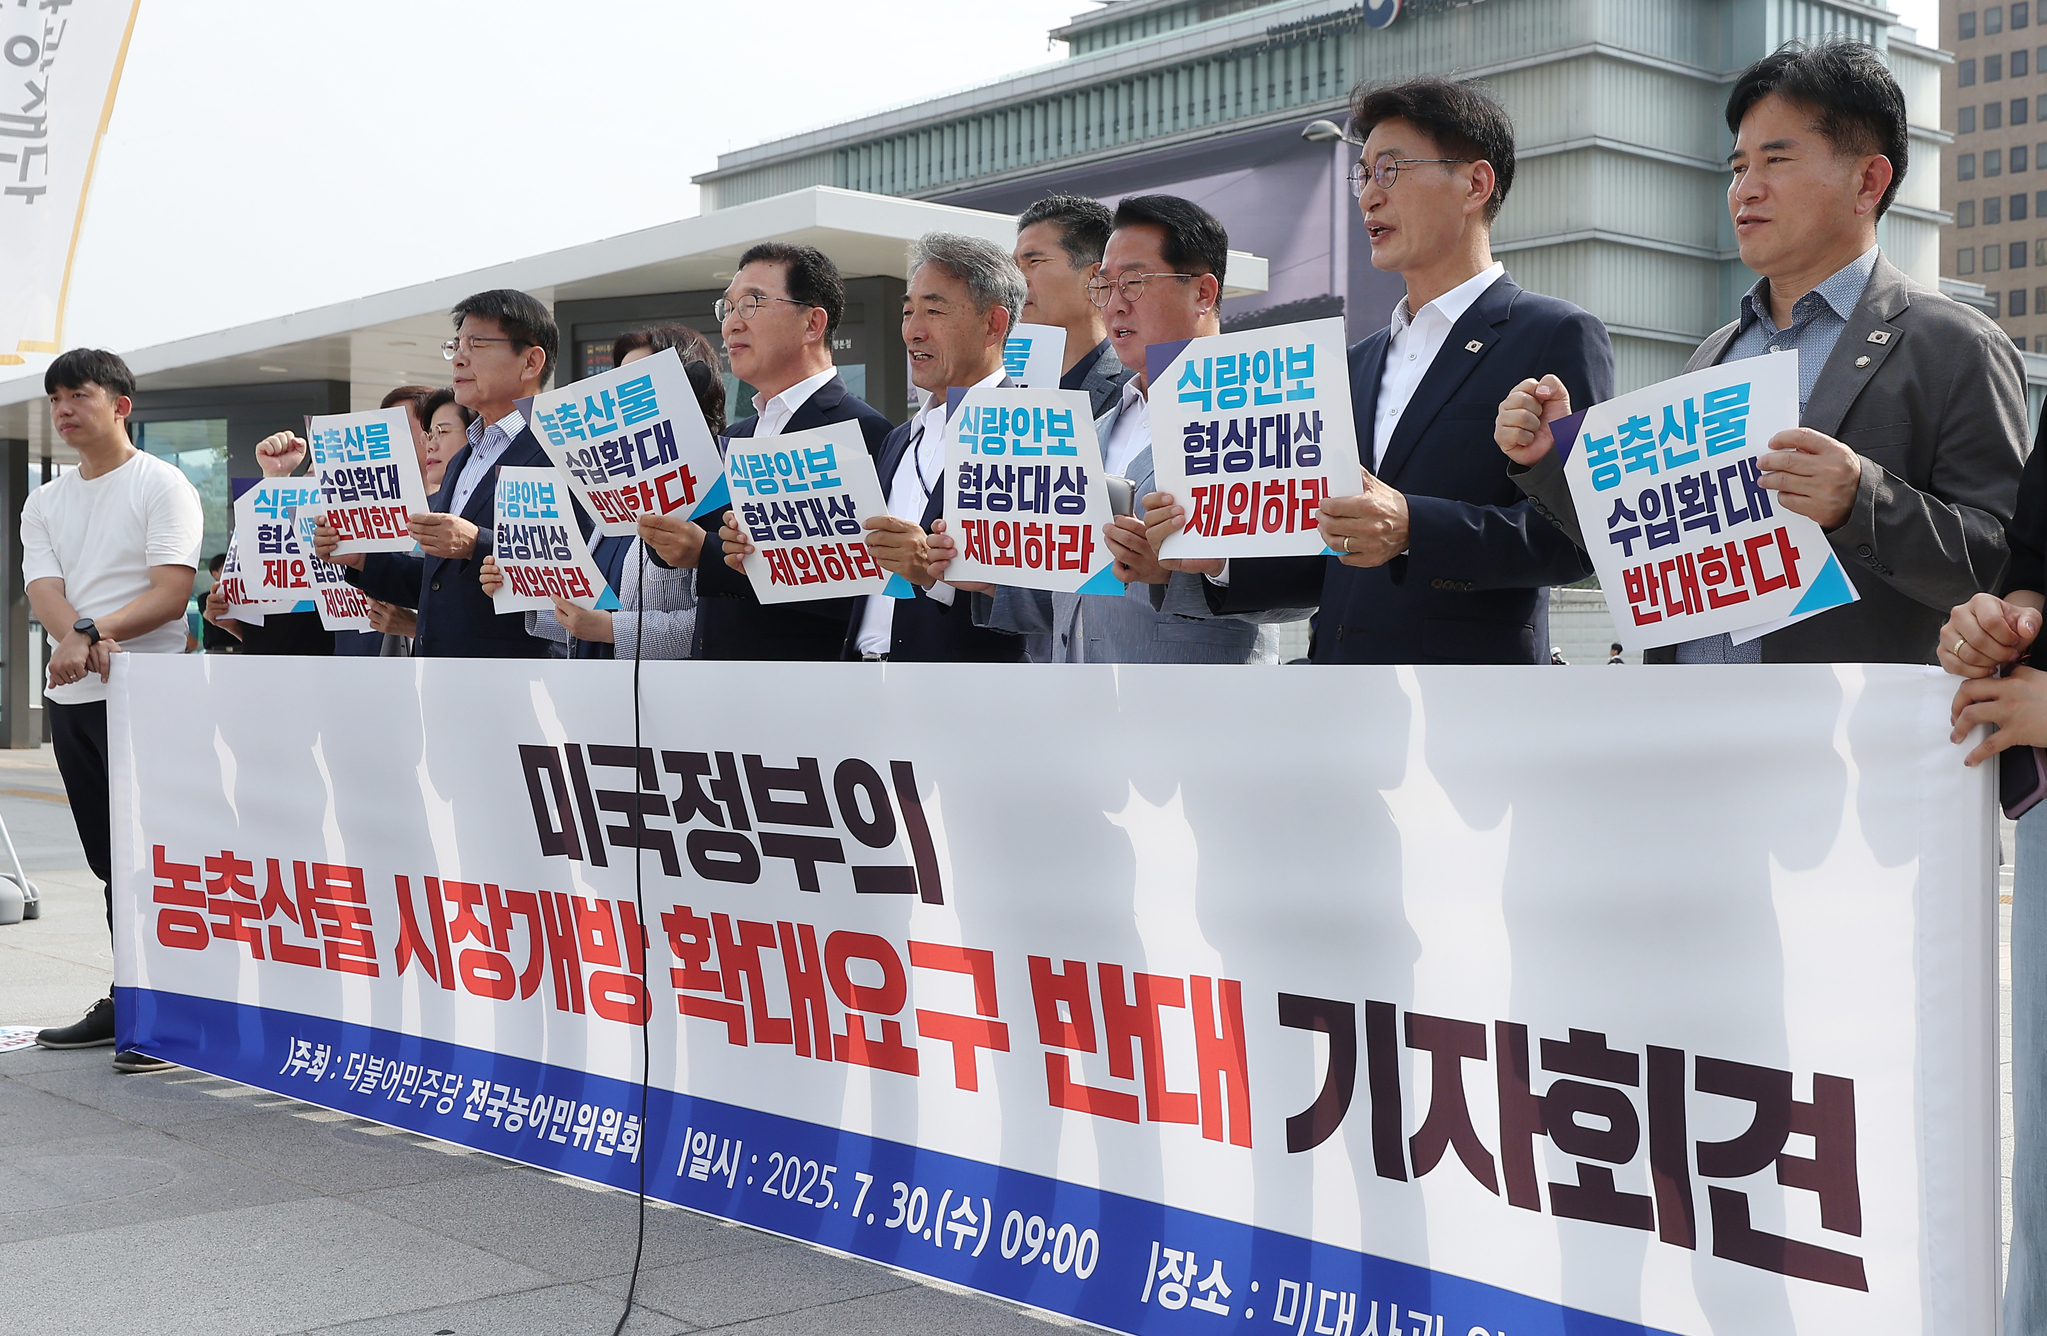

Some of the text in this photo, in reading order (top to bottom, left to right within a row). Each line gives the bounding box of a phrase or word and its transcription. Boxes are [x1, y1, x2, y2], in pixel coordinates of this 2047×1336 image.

[1177, 343, 1315, 412] 식량안보
[535, 374, 660, 446] 농축산물
[959, 405, 1078, 456] 식량안보
[1583, 382, 1751, 492] 농축산물
[312, 422, 391, 464] 농축산물
[565, 419, 680, 486] 수입확대
[731, 443, 842, 496] 식량안보
[1183, 410, 1323, 476] 협상대상
[320, 464, 401, 504] 수입확대
[497, 480, 559, 519] 식량안보
[587, 463, 698, 524] 반대한다
[958, 461, 1088, 515] 협상대상
[1182, 476, 1331, 537] 제외하라
[1607, 456, 1774, 557] 수입확대
[327, 505, 411, 540] 반대한다
[497, 523, 572, 561] 협상대상
[740, 494, 861, 542] 협상대상
[961, 519, 1094, 574] 제외하라
[504, 566, 595, 600] 제외하라
[762, 543, 884, 586] 제외하라
[1622, 526, 1801, 626] 반대한다
[518, 742, 945, 905] 미국정부의
[152, 844, 1870, 1293] 농축산물 시장개방 확대요구 반대 기자회견
[343, 1052, 464, 1115] 더불어민주당
[462, 1078, 647, 1164] 전국농어민위원회
[762, 1151, 839, 1210] 2025.
[851, 1171, 875, 1226] 7.
[1000, 1209, 1100, 1280] 09:00
